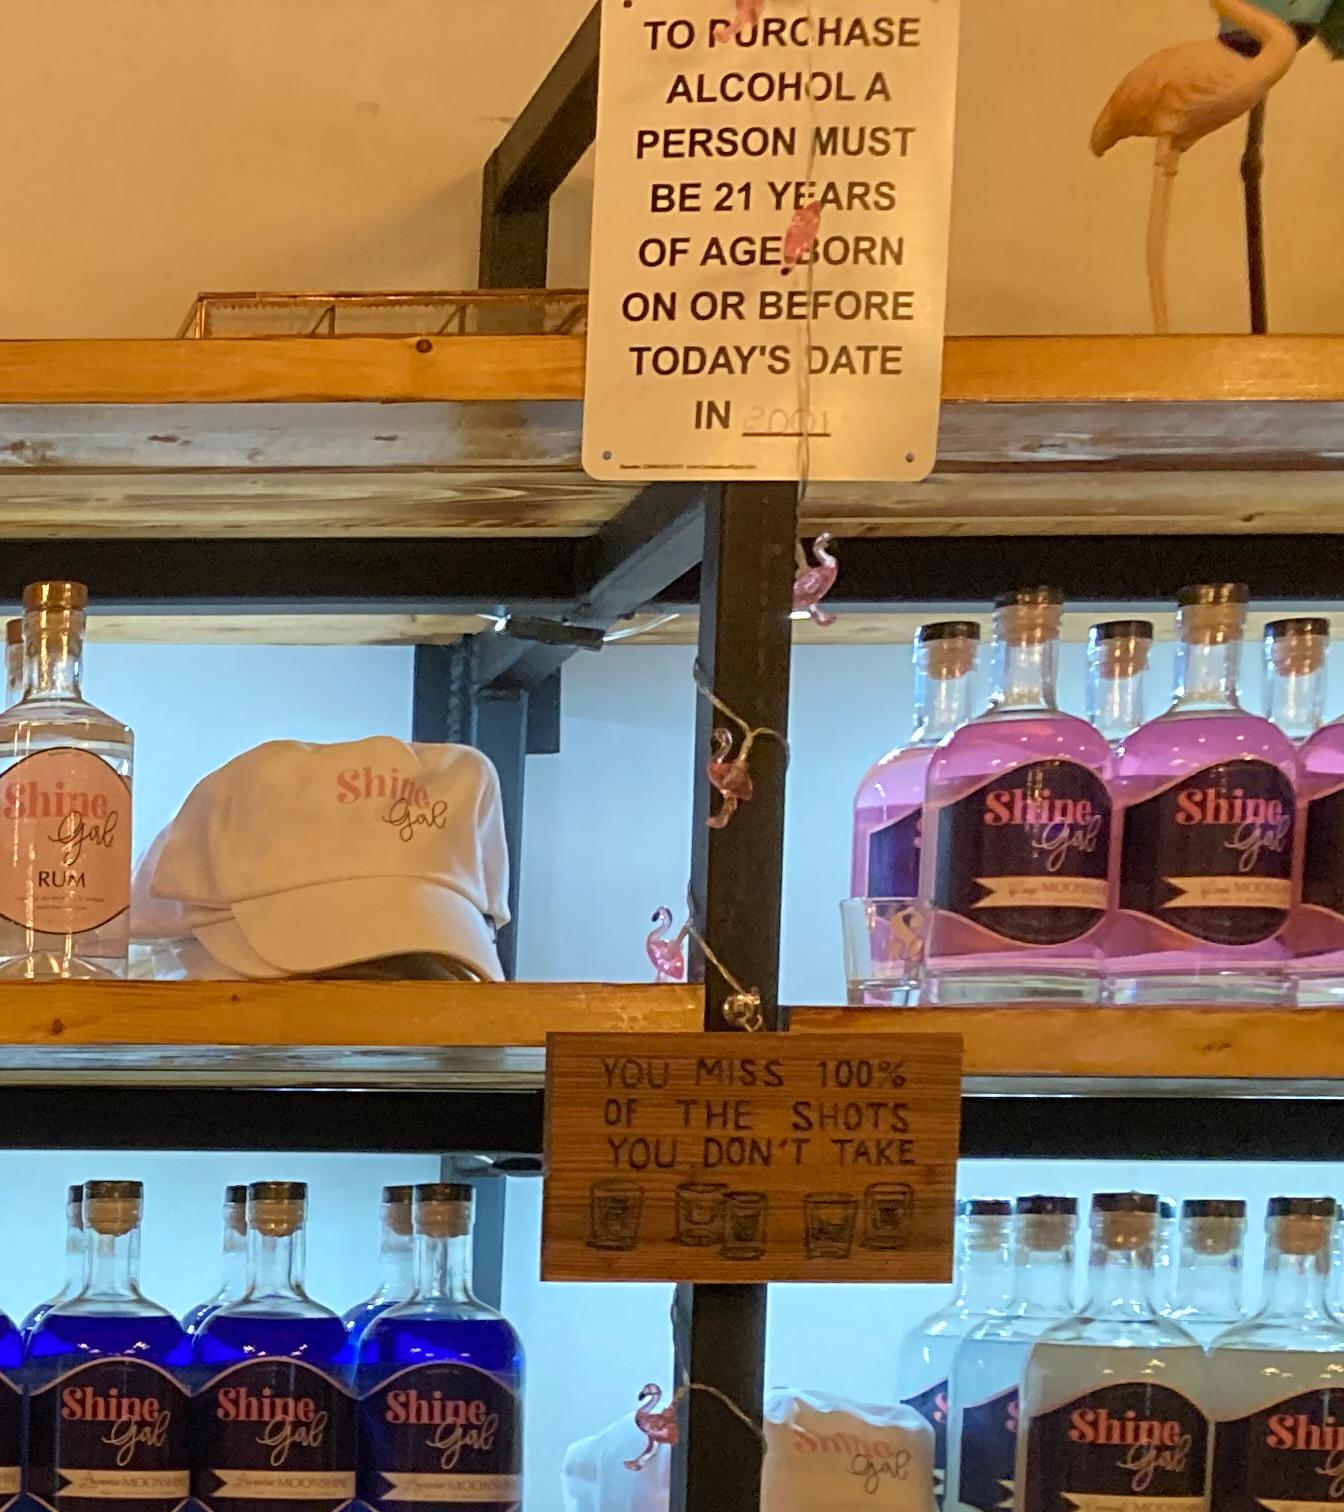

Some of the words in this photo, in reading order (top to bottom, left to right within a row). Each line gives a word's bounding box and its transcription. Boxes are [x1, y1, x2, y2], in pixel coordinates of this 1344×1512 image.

[644, 19, 695, 50] TO
[708, 17, 920, 48] PURCHASE
[666, 72, 855, 104] ALCOHOL
[865, 72, 892, 101] A
[636, 128, 796, 160] PERSON
[813, 127, 916, 157] MUST
[651, 183, 702, 213] BE
[715, 183, 751, 211] 21
[768, 181, 897, 211] YEARS
[639, 237, 690, 268] OF
[700, 236, 782, 267] AGE
[799, 236, 904, 266] BORN
[622, 292, 676, 321] ON
[691, 292, 745, 321] OR
[759, 291, 914, 320] BEFORE
[630, 345, 790, 376] TODAY'S
[809, 345, 903, 375] DATE
[695, 401, 730, 430] IN
[337, 766, 430, 809] Shine
[983, 789, 1093, 825] Shine
[1175, 789, 1282, 825] Shine
[38, 871, 85, 889] RUM
[602, 1058, 670, 1089] YOU
[695, 1058, 785, 1087] MISS
[817, 1059, 907, 1088] 100%
[604, 1100, 636, 1126] OF
[678, 1100, 752, 1130] THE
[792, 1101, 909, 1134] SHOTS
[608, 1137, 675, 1169] YOU
[704, 1137, 811, 1168] DON'T
[832, 1139, 914, 1166] TAKE
[61, 1387, 159, 1421] Shine
[217, 1388, 315, 1422] Shine
[386, 1389, 486, 1424] Shine
[1069, 1408, 1180, 1446] Shine
